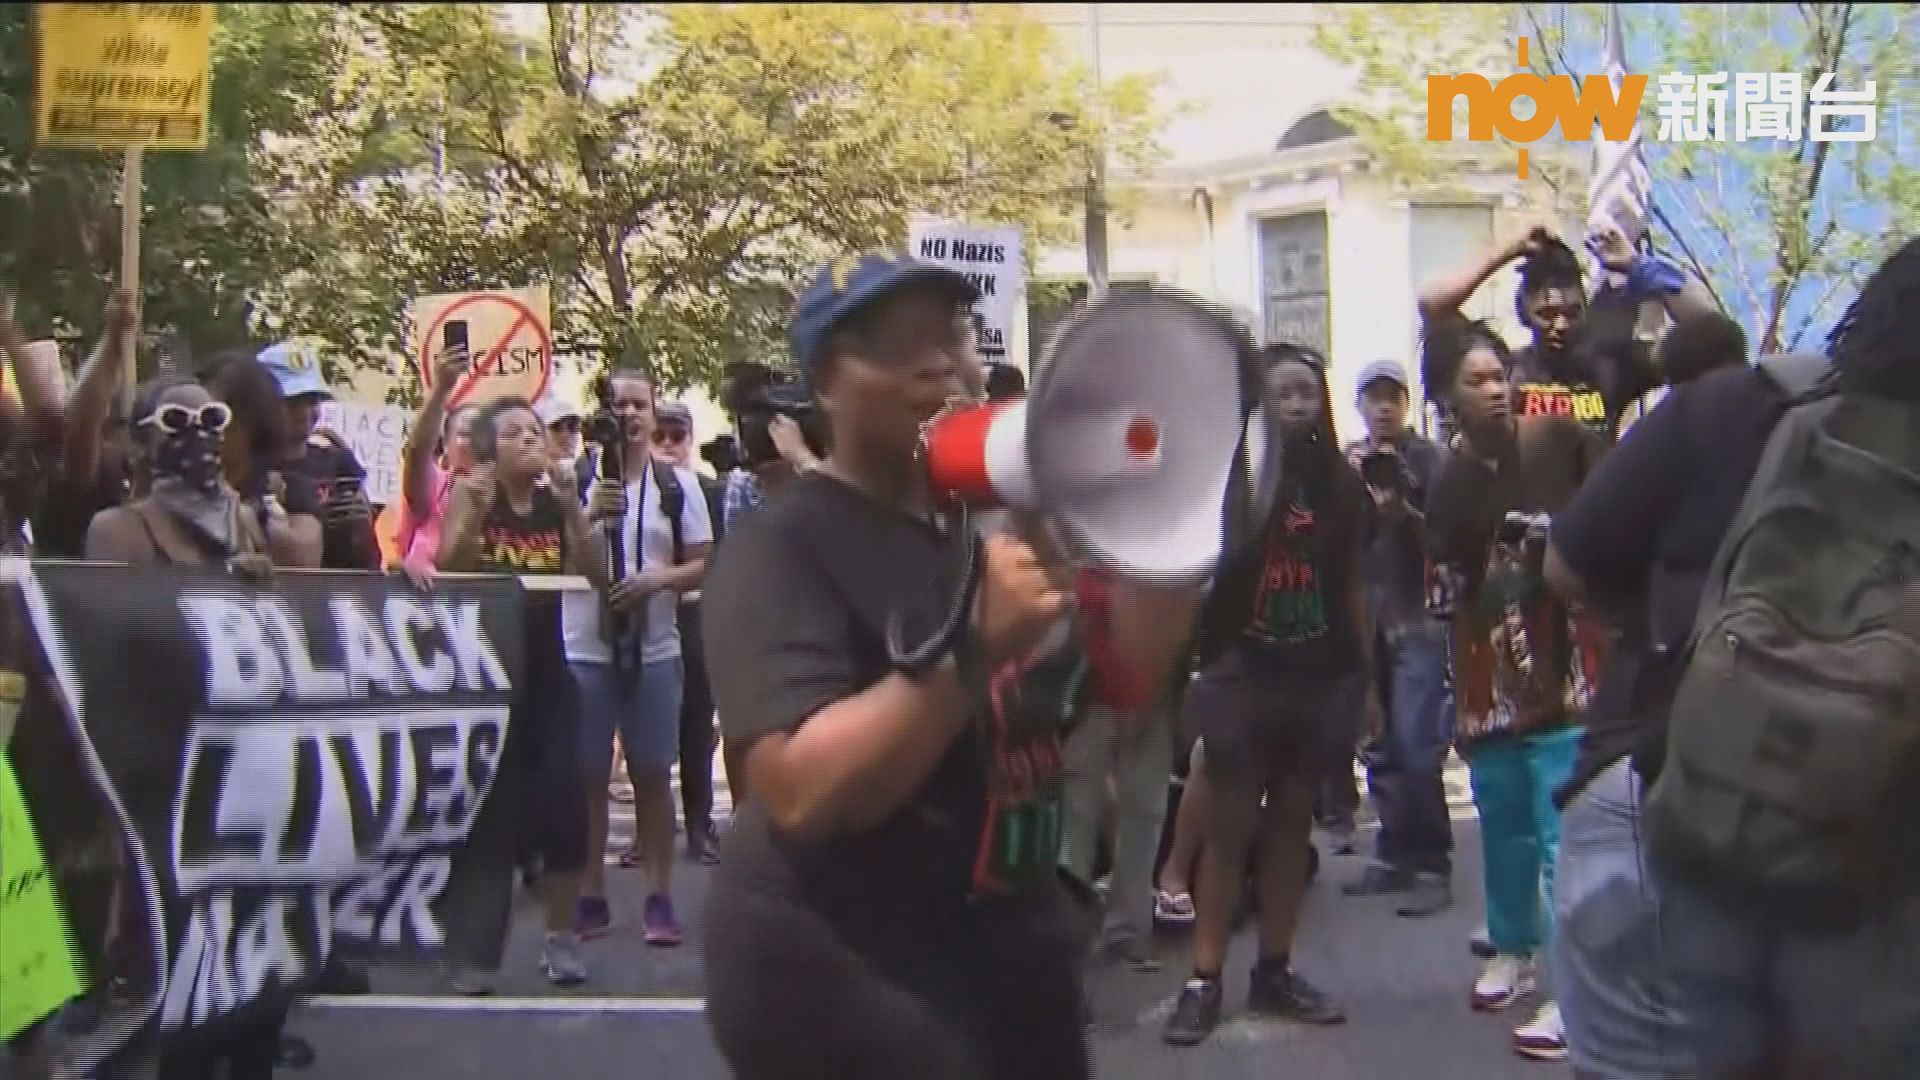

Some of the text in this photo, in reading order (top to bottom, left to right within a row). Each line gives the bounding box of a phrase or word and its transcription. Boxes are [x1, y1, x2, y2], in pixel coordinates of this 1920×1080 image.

[920, 237, 1005, 263] NO Nazis
[177, 591, 511, 706] BLACK
[176, 710, 507, 872] LIVES
